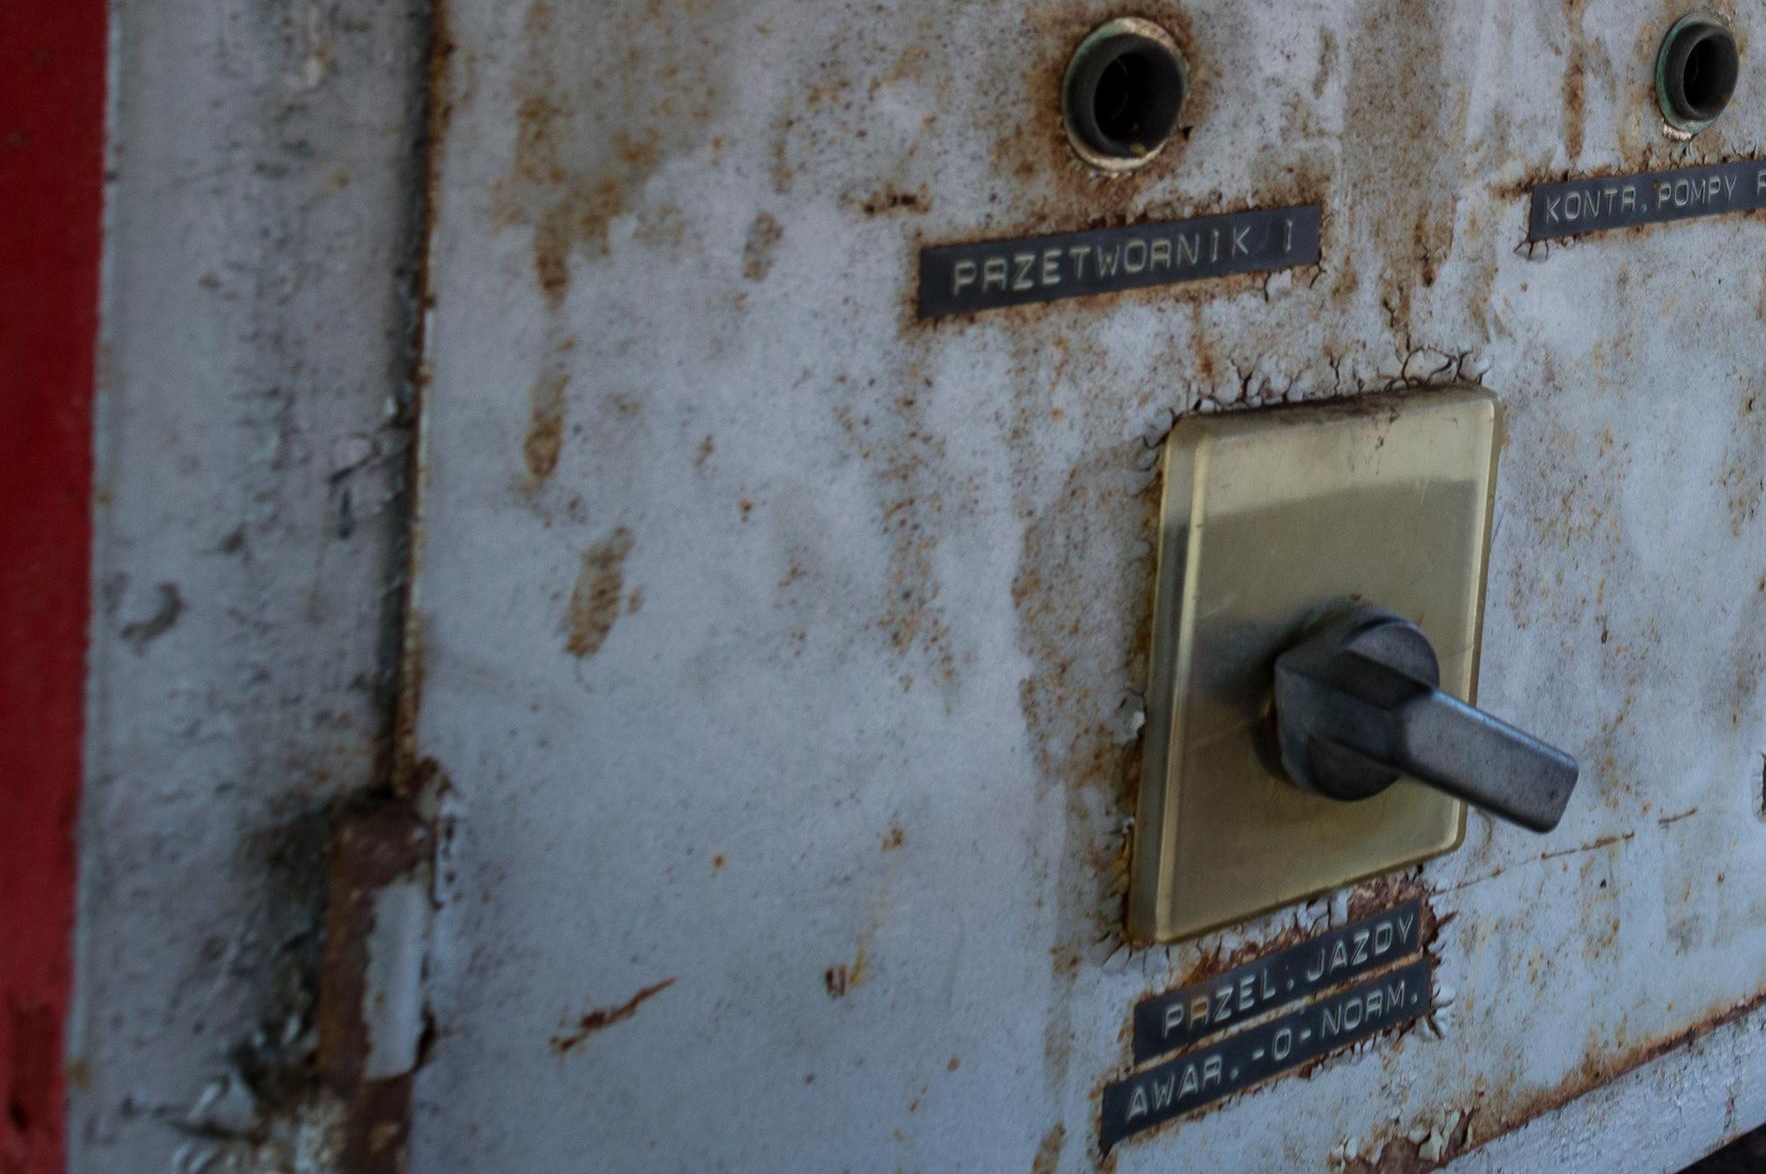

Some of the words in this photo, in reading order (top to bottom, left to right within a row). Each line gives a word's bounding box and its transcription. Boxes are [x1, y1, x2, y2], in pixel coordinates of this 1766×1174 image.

[1656, 174, 1738, 211] POMPY
[953, 224, 1253, 298] PRZETWORNIK
[1306, 912, 1416, 983] JAZDY
